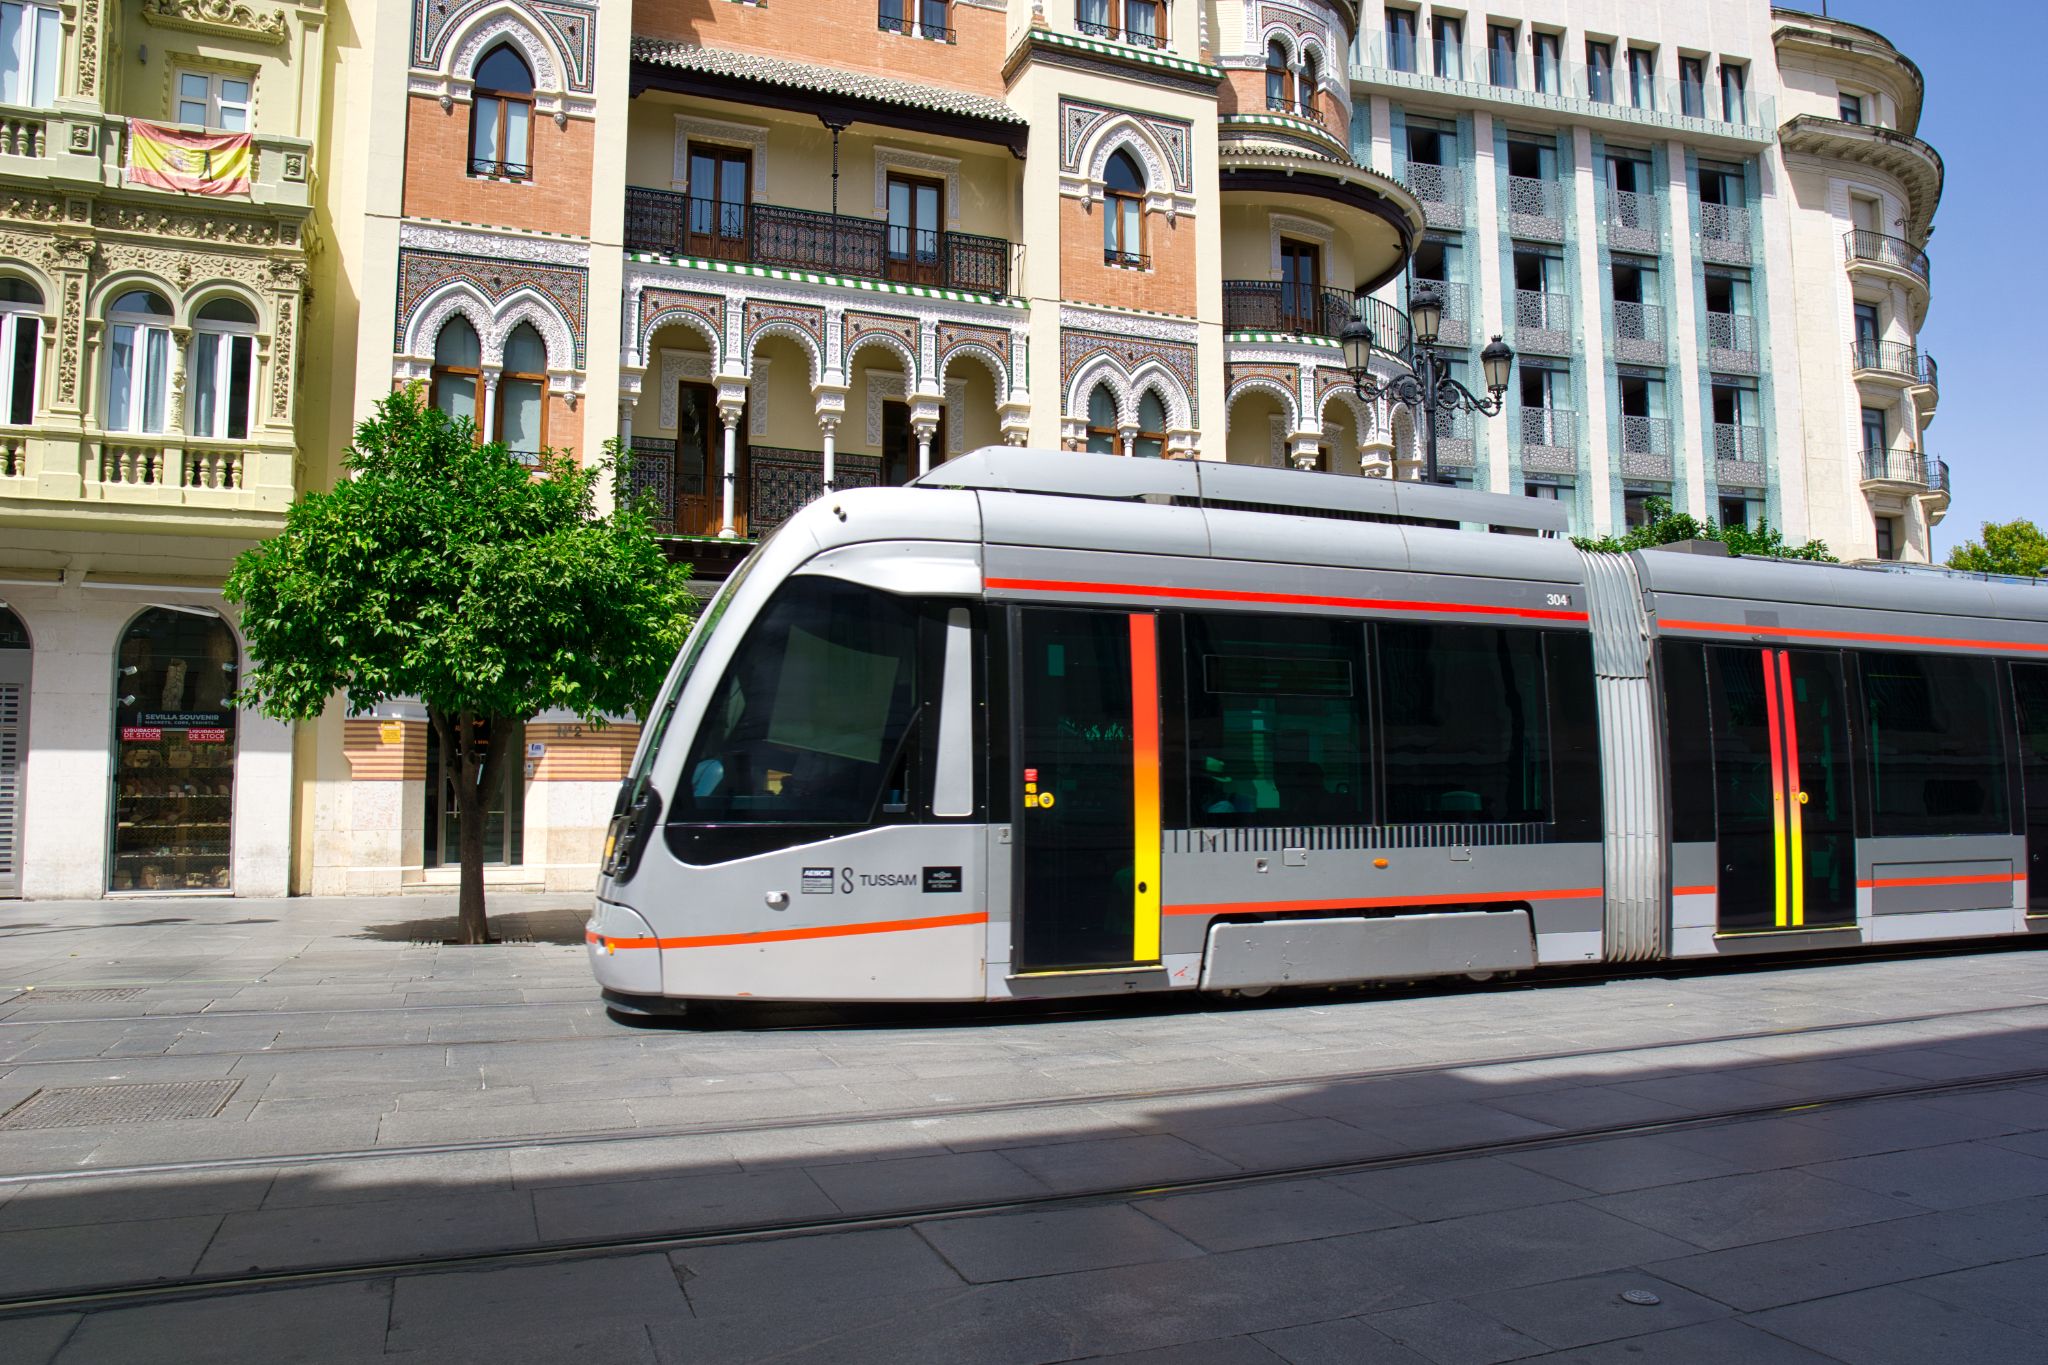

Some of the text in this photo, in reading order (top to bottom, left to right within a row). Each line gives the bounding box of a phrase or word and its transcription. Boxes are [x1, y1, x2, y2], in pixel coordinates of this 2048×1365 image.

[1546, 593, 1568, 606] 304
[574, 726, 582, 737] 2
[859, 874, 917, 886] TUSSAM
